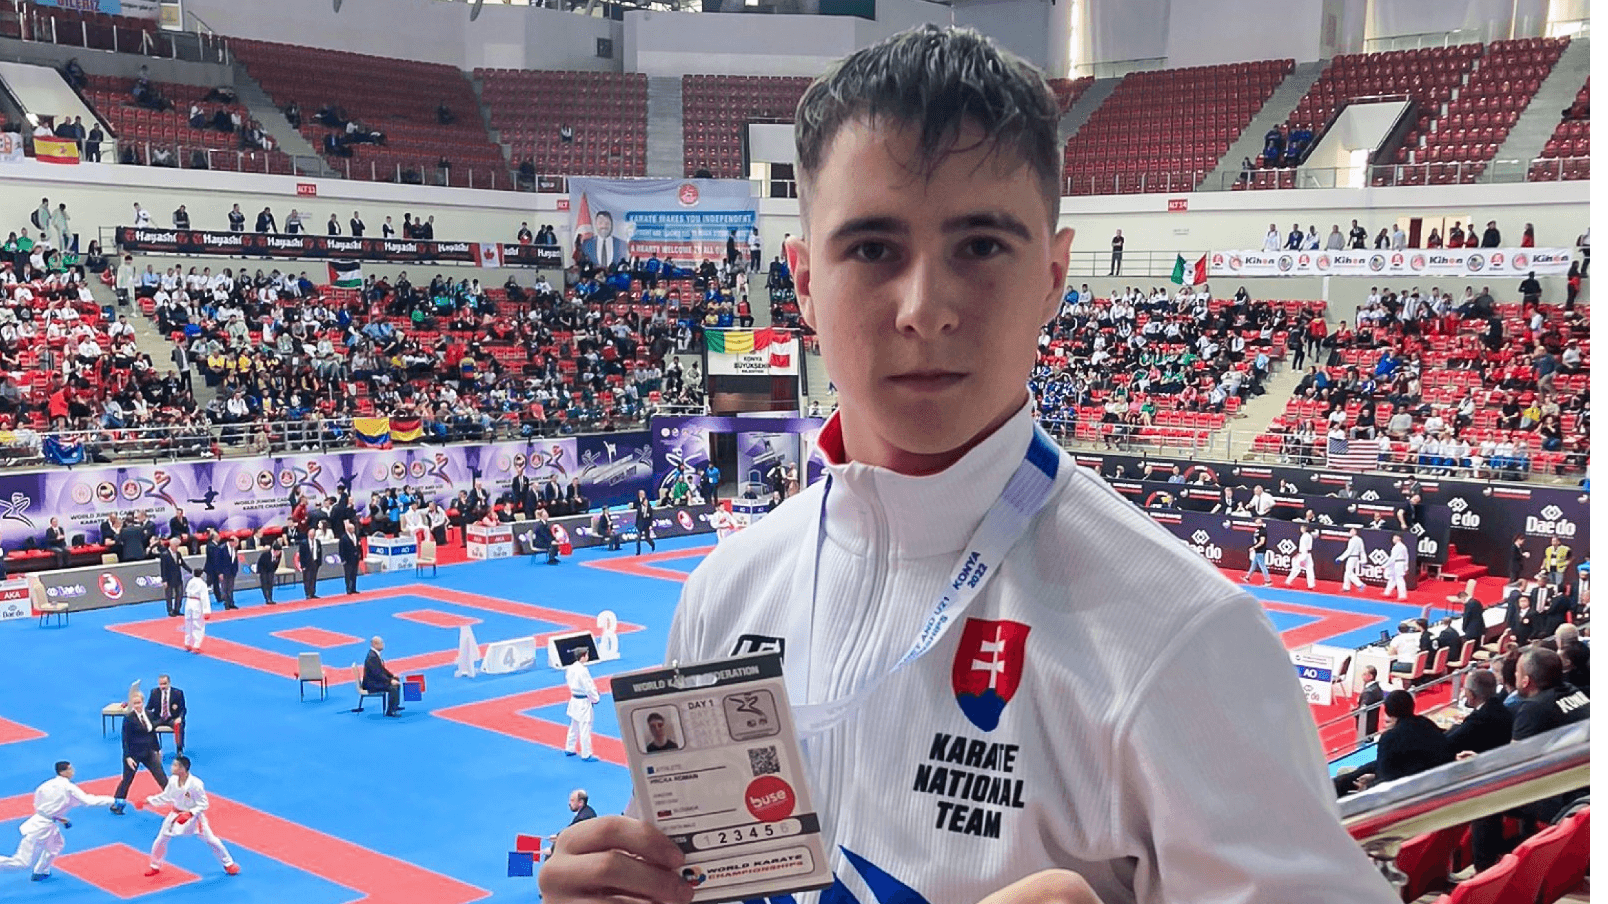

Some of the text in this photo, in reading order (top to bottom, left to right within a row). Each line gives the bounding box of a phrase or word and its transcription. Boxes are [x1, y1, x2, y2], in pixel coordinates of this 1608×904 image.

[135, 231, 177, 244] Hayashi
[202, 234, 242, 246] Hayashi
[267, 236, 304, 248] Hayashi
[327, 238, 362, 251] Hayashi
[384, 242, 417, 254] Hayashi
[1245, 256, 1275, 266] Kihon
[1334, 256, 1366, 265] Kihon
[1429, 256, 1463, 264] Kihon
[1532, 254, 1569, 263] Kihon
[967, 562, 988, 588] 2022
[934, 596, 950, 616] U21
[952, 551, 981, 590] KONYA
[4, 591, 21, 600] AKA
[1303, 668, 1318, 678] AO
[632, 680, 666, 692] WORLD
[688, 700, 706, 710] DAY
[912, 763, 1025, 808] NATIONAL
[750, 788, 787, 808] buse
[936, 800, 1002, 839] TEAM
[718, 832, 728, 844] 2
[734, 830, 743, 842] 3
[750, 827, 758, 838] 4
[765, 824, 774, 836] 5
[707, 854, 802, 874] WORLD KARATE
[708, 861, 803, 880] CHAMPIONSHIPS
